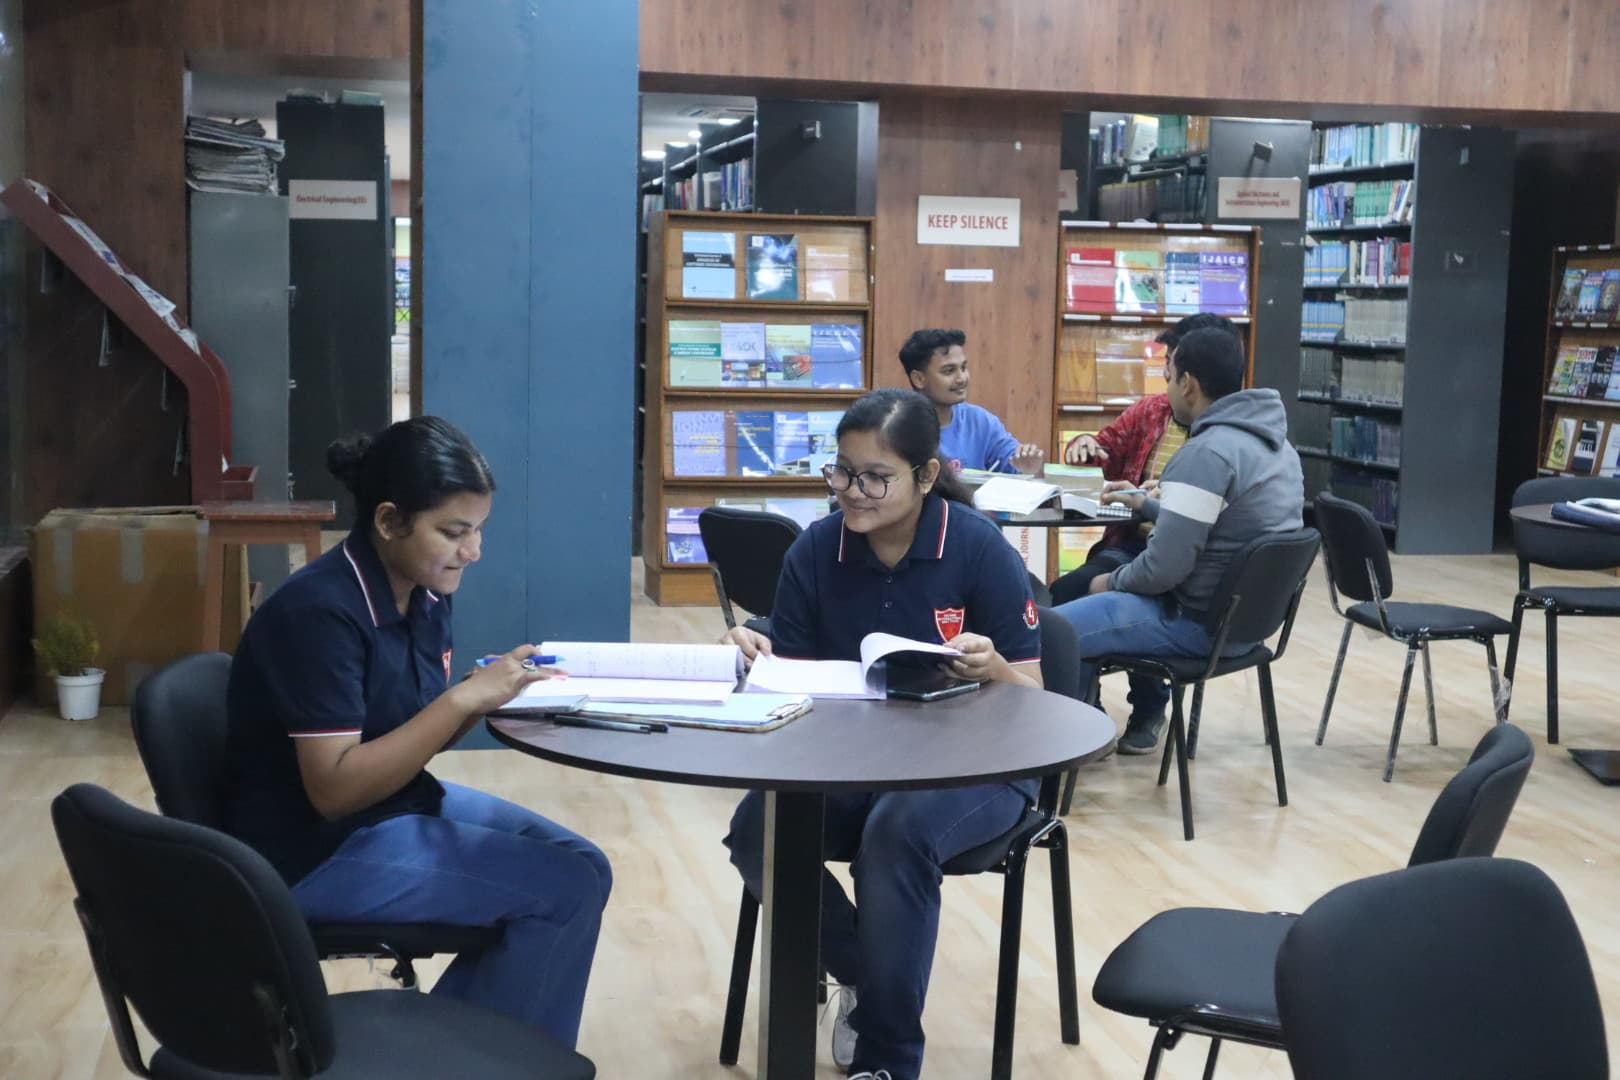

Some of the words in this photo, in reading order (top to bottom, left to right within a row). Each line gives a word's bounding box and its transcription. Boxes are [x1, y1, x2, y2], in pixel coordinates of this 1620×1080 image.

[927, 214, 958, 229] KEEP
[960, 215, 1009, 230] SILENCE
[1019, 527, 1030, 555] JOURN
